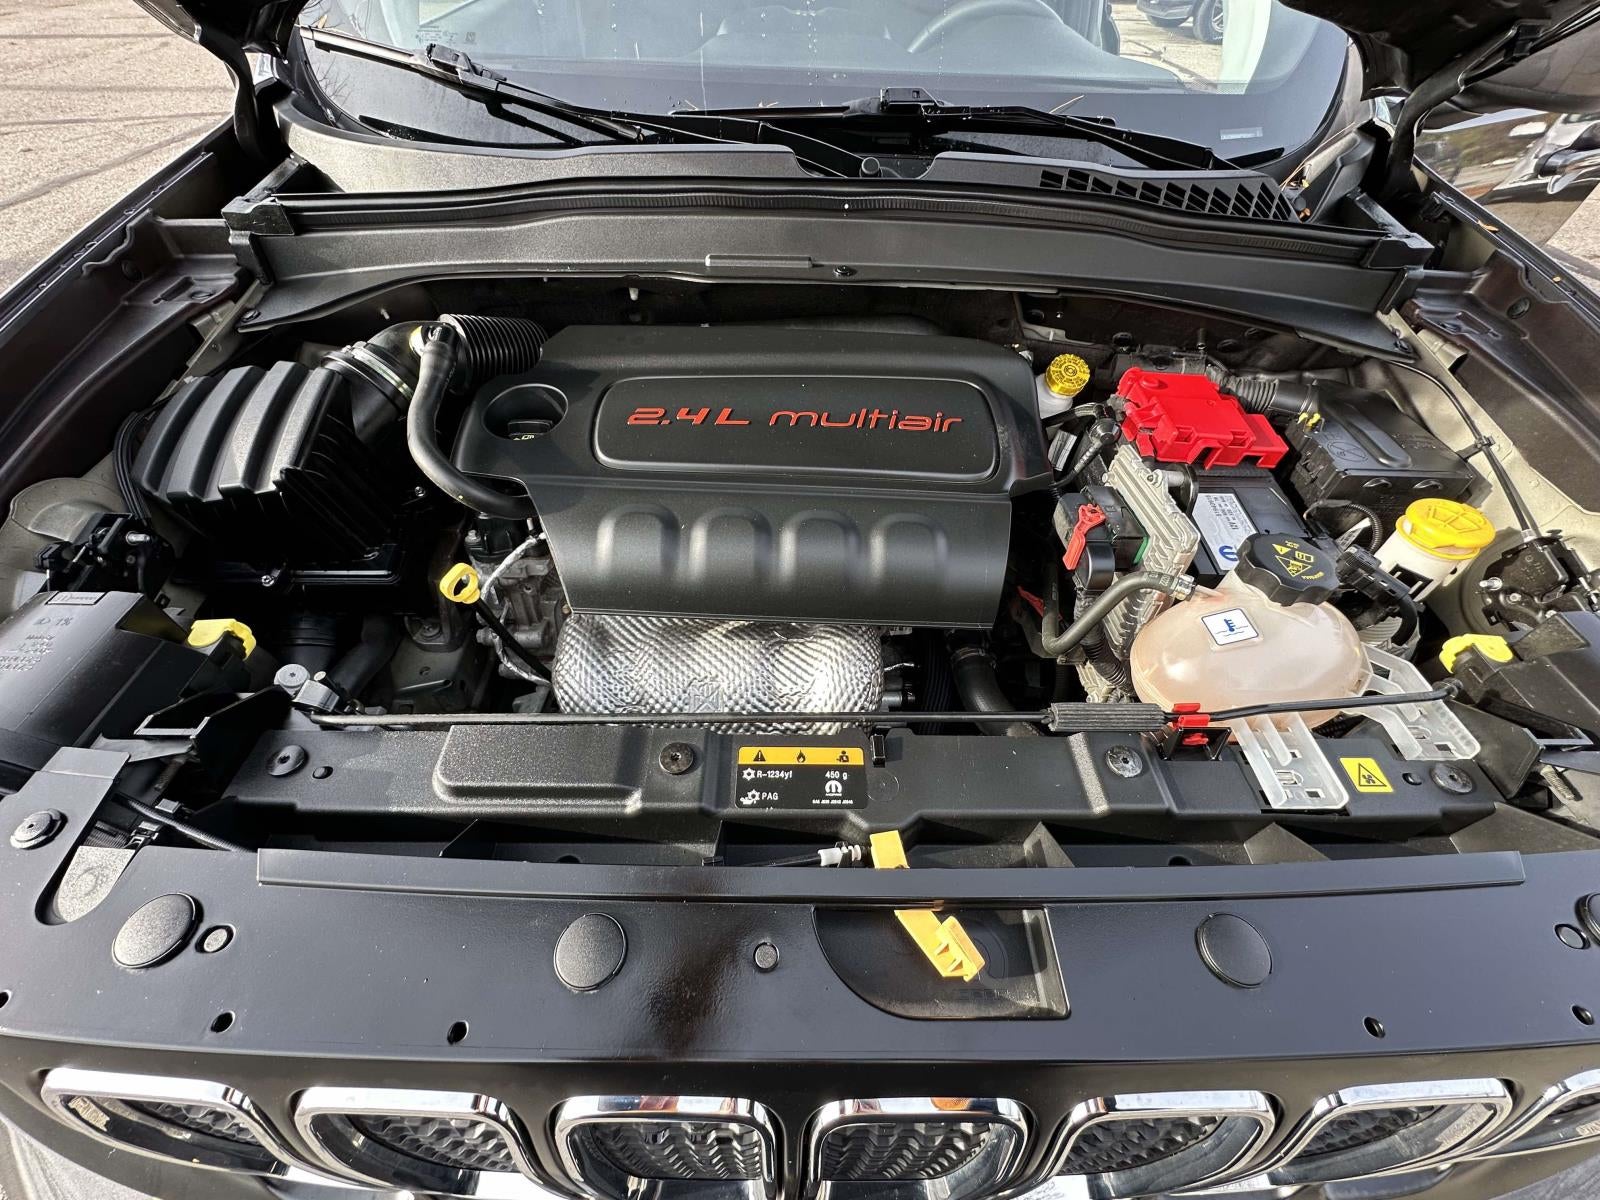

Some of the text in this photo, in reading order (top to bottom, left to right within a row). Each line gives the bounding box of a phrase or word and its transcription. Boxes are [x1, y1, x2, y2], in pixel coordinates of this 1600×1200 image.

[768, 408, 964, 432] multiair
[825, 771, 840, 779] 450
[761, 792, 779, 800] PAG
